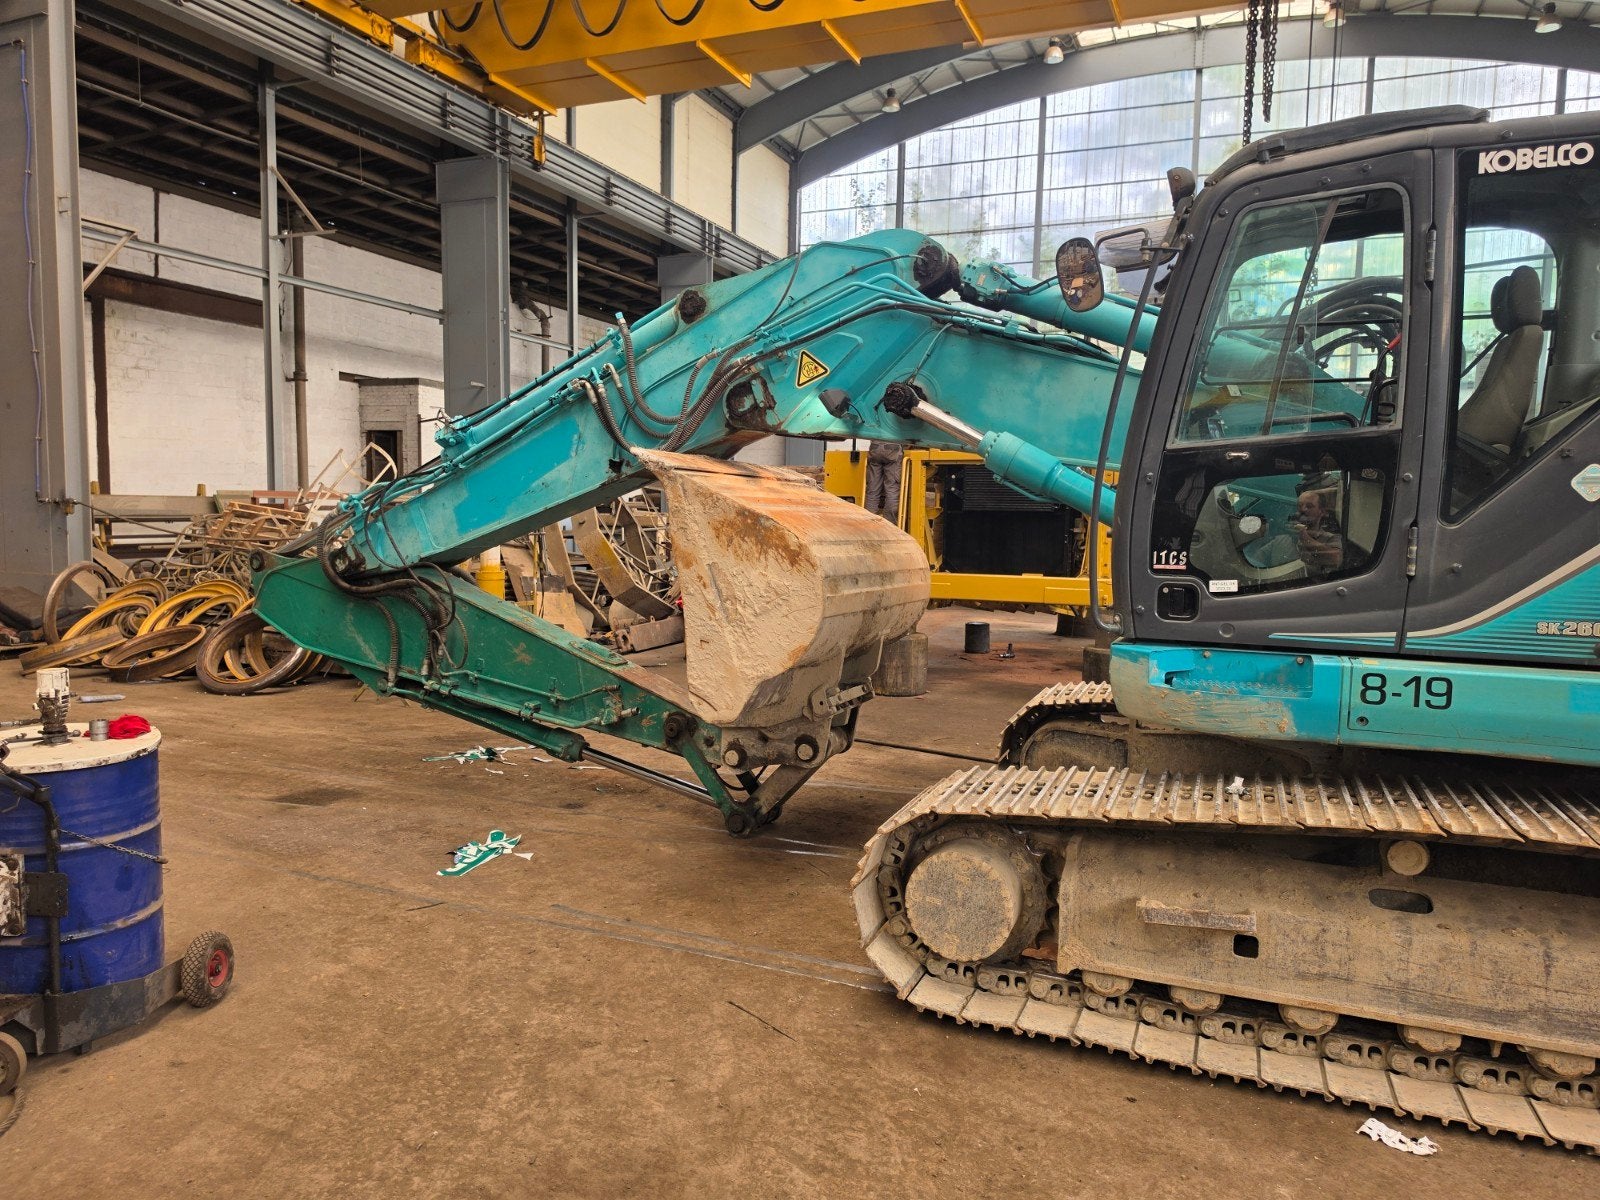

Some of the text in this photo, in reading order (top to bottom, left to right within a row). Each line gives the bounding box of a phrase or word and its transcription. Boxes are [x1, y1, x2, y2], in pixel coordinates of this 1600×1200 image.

[1478, 142, 1594, 174] KOBELCO
[1153, 550, 1187, 565] ITCS
[1360, 673, 1453, 710] 8-19
